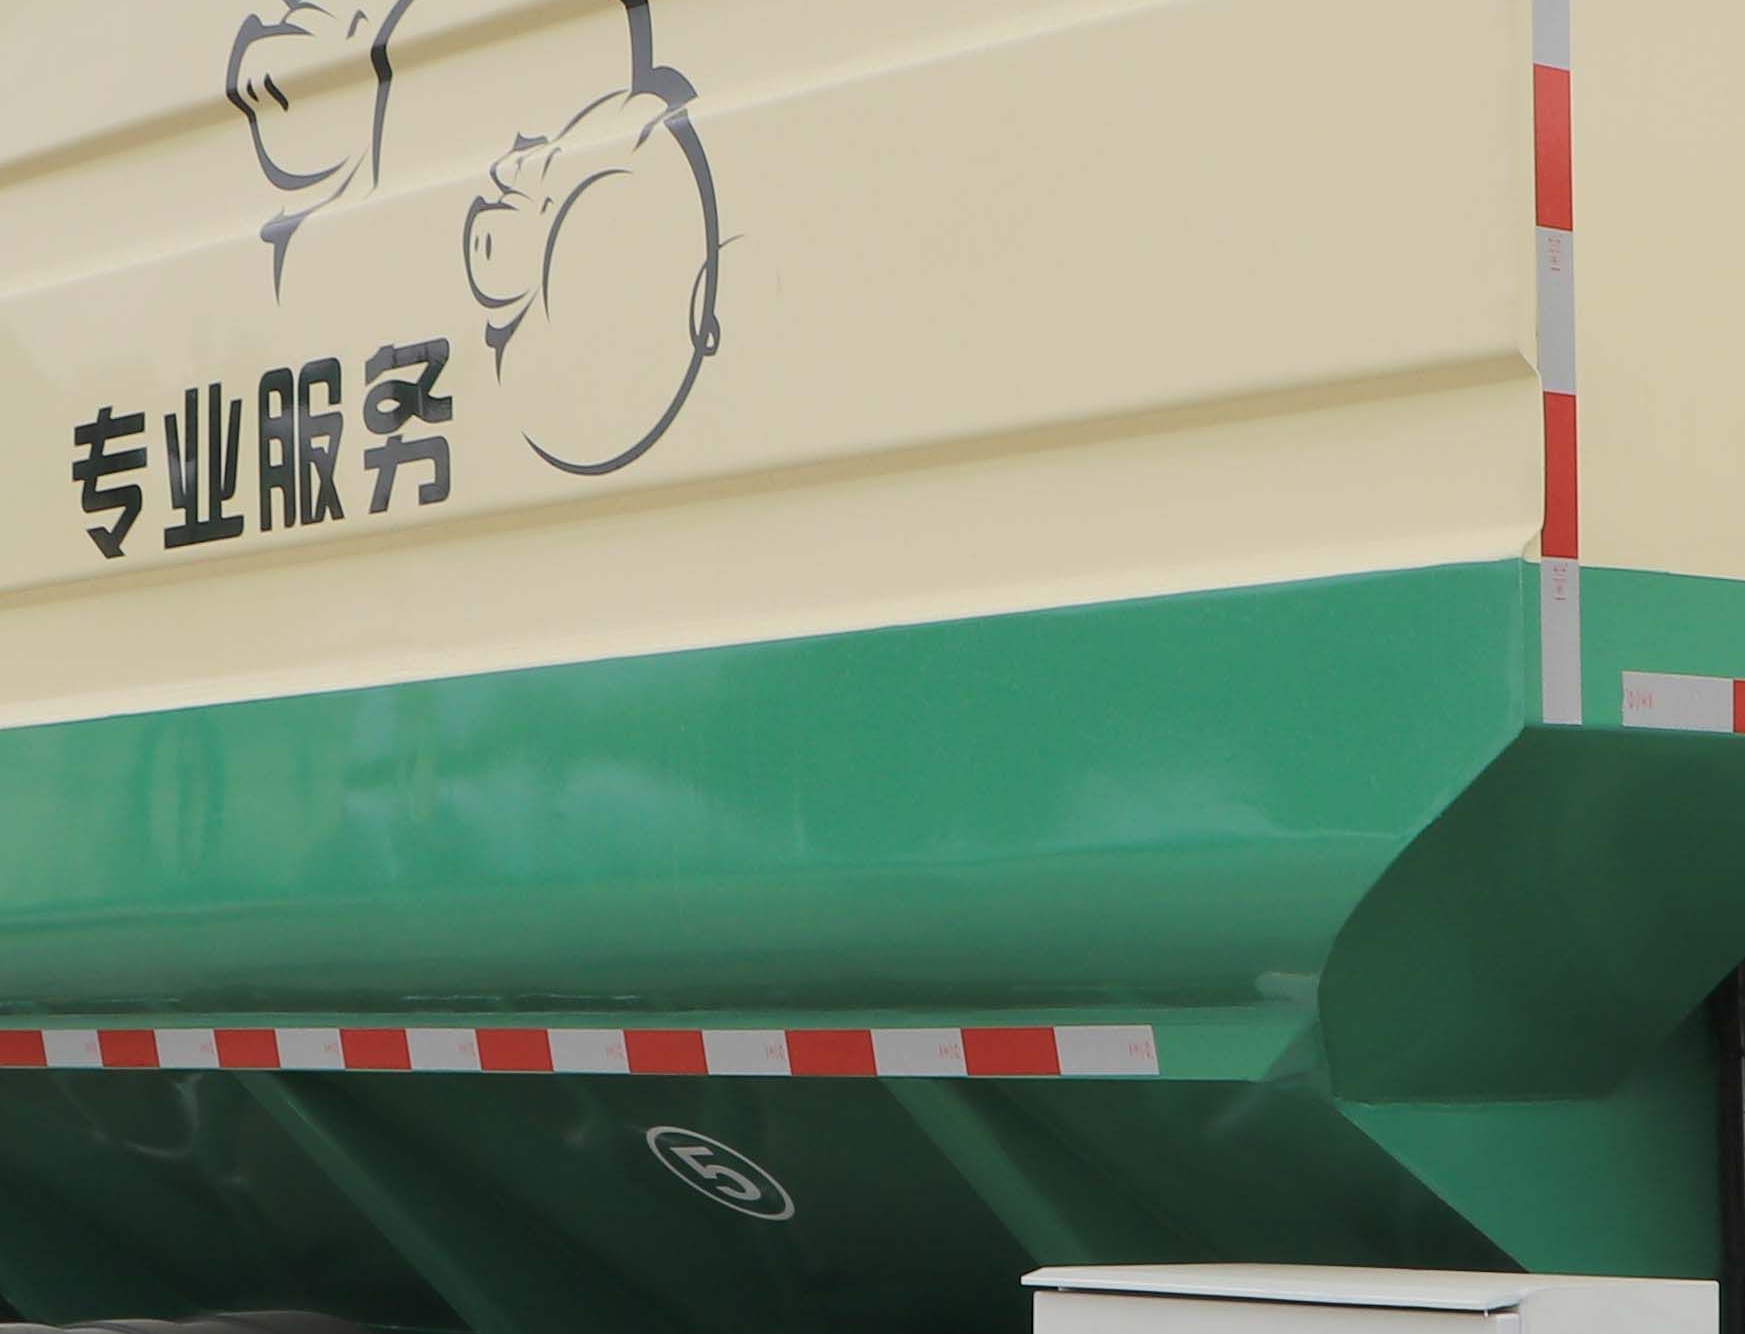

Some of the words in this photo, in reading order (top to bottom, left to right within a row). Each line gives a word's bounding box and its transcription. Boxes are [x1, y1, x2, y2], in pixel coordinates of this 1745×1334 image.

[71, 337, 453, 559] 专业服务
[670, 1146, 762, 1201] 5
